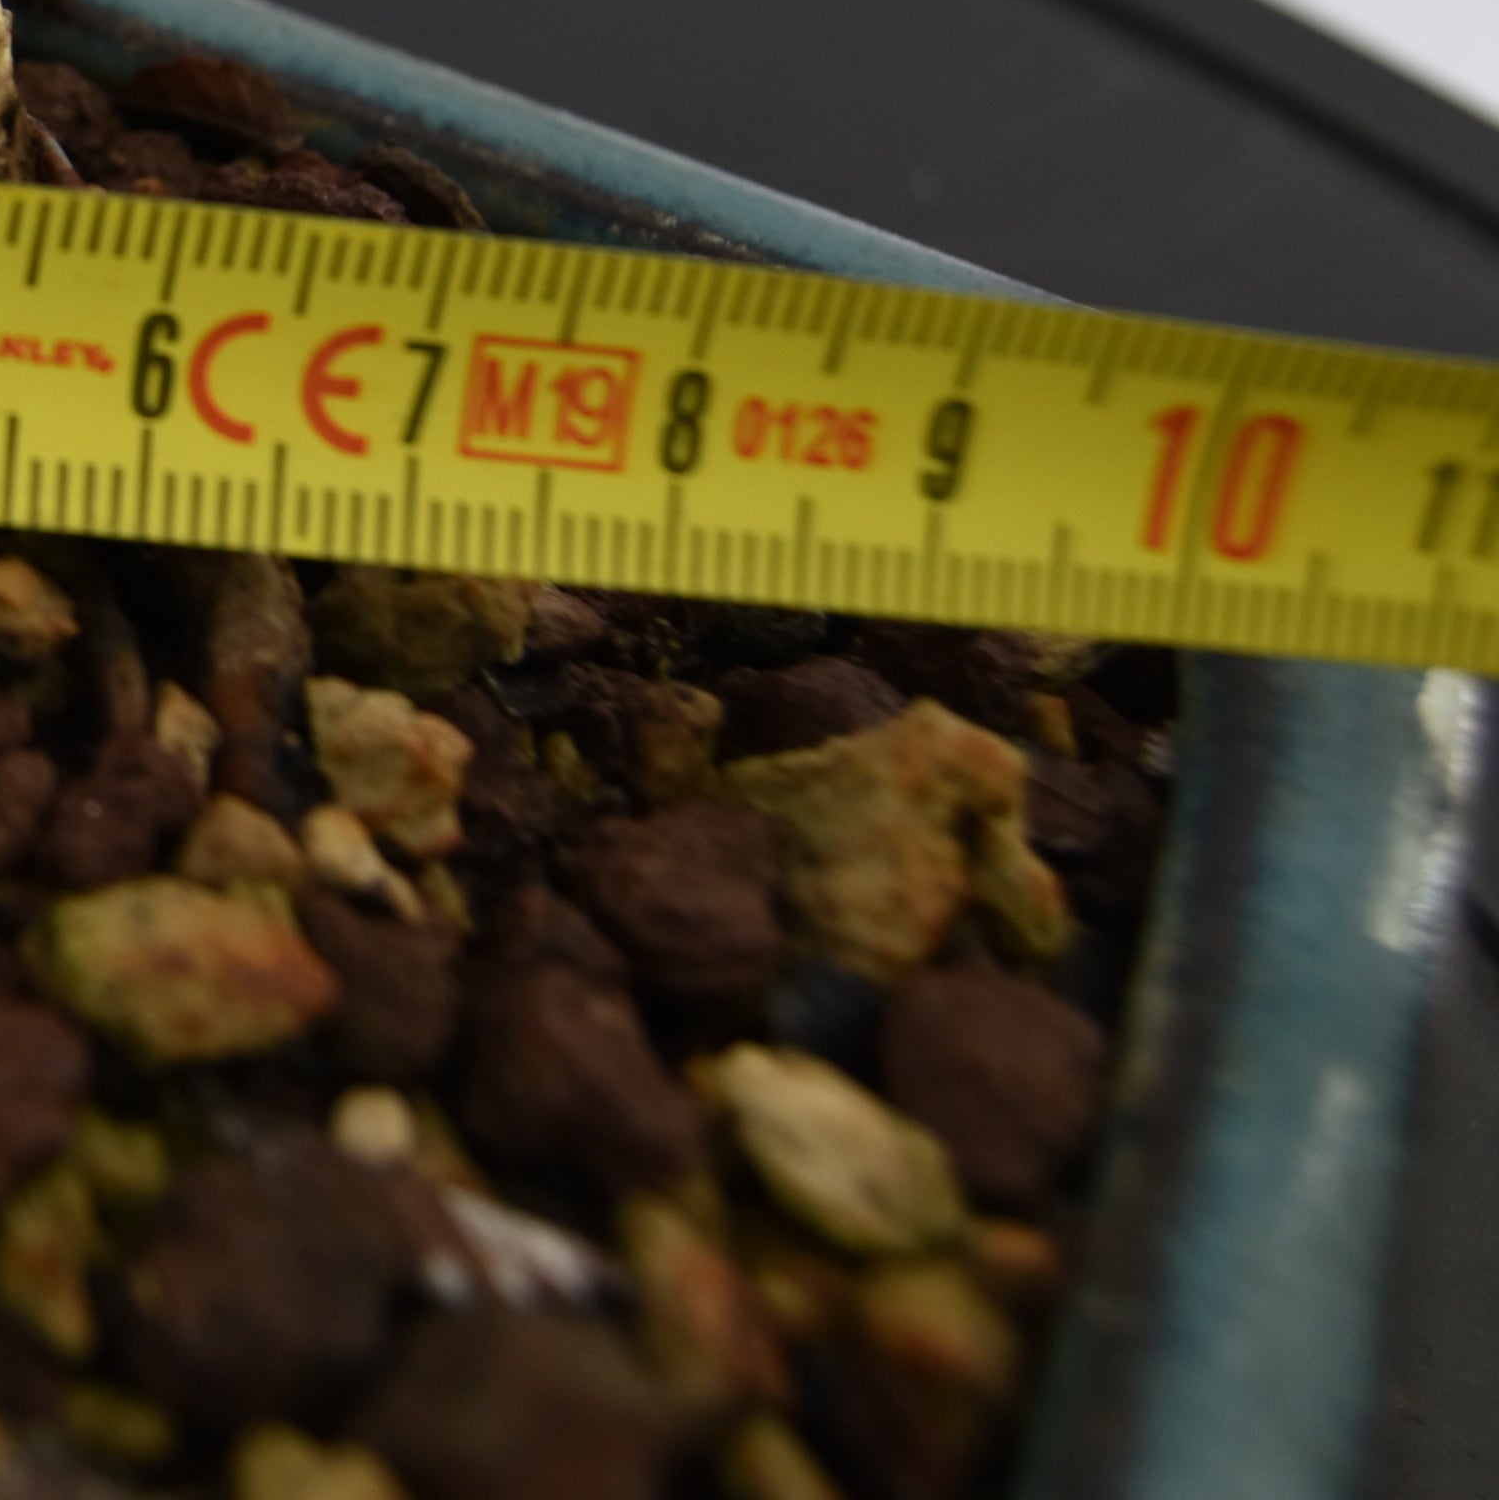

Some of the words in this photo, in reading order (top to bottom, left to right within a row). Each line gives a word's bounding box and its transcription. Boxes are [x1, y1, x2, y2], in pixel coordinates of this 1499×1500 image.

[130, 312, 181, 419] 6
[401, 343, 449, 445] 7
[661, 370, 712, 474] 8
[732, 397, 879, 471] 0126
[920, 398, 973, 501] 9
[1139, 404, 1306, 561] 10
